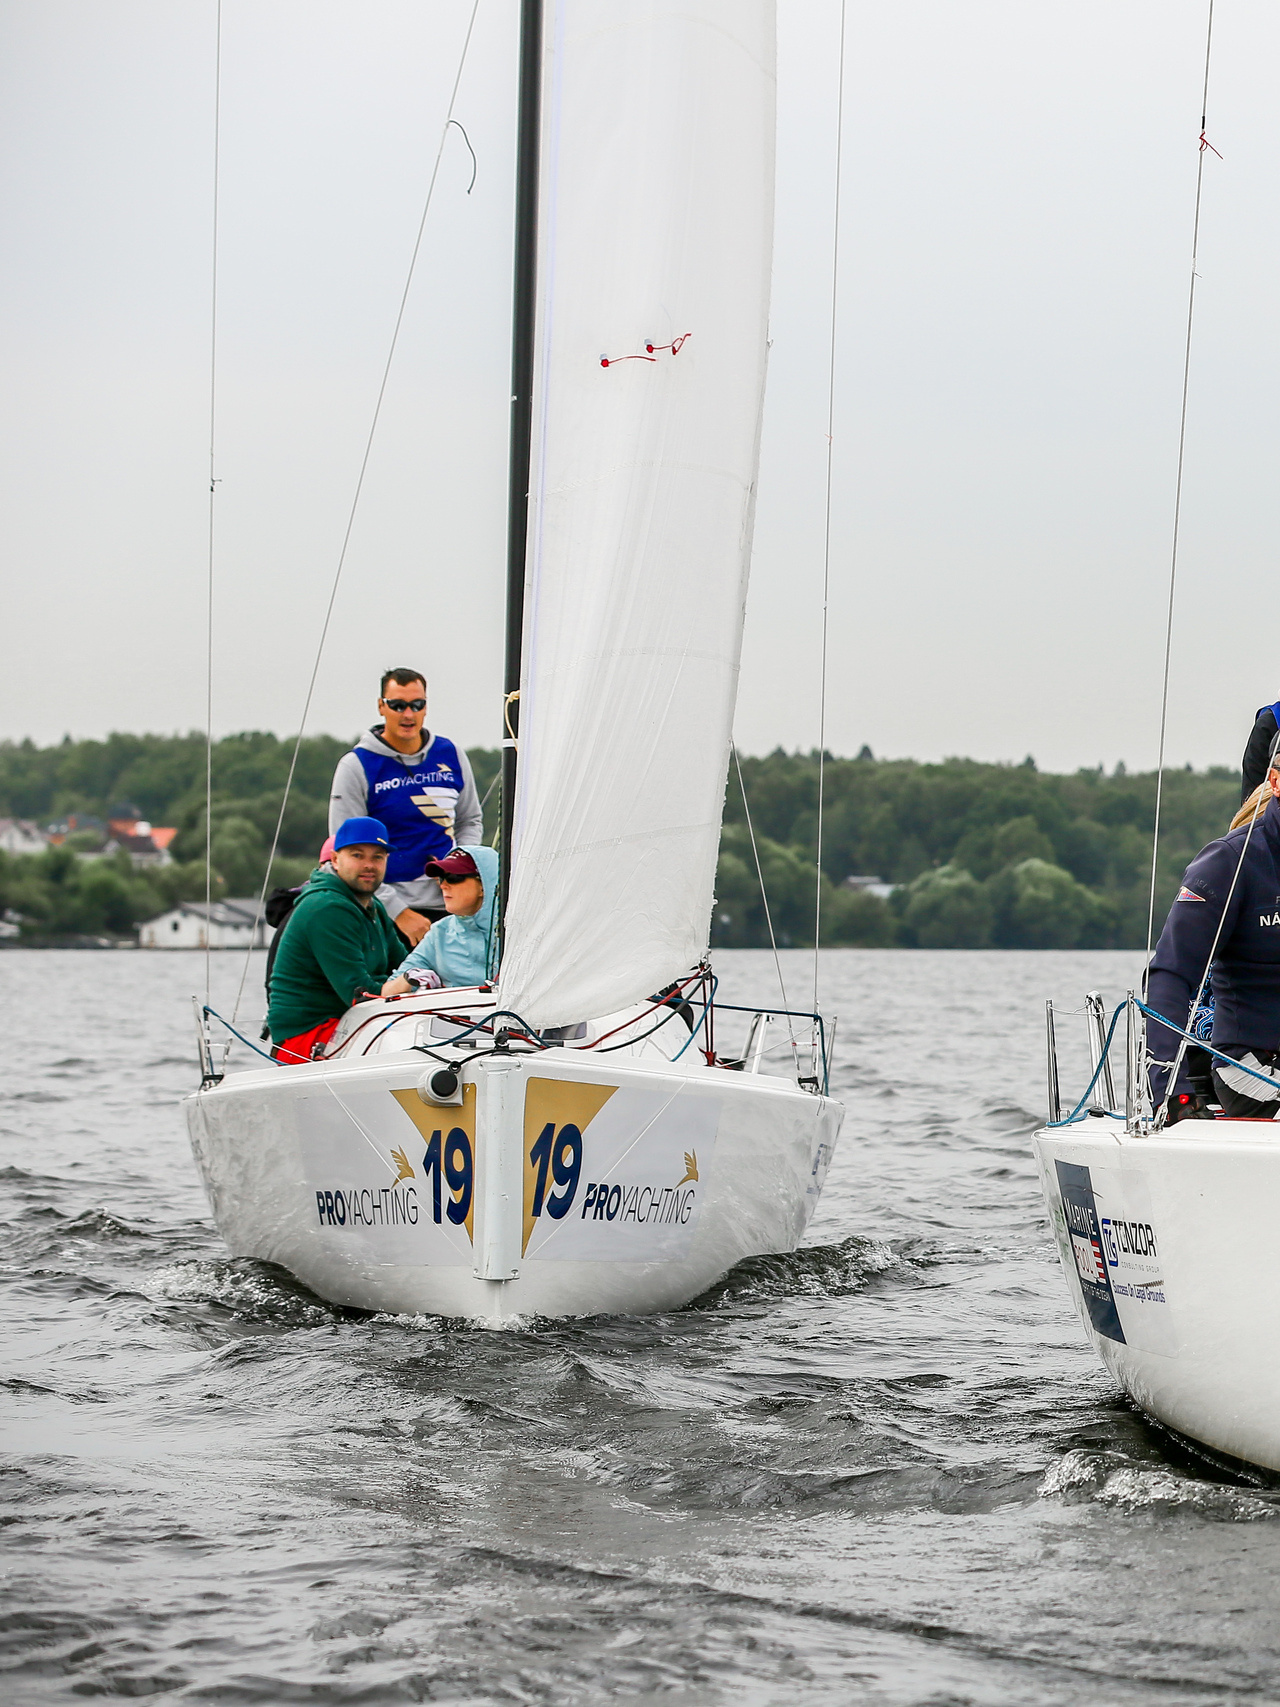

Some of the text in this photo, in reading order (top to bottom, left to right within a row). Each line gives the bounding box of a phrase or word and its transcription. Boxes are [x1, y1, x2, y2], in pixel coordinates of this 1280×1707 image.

[375, 771, 455, 794] PROYACHTING
[422, 1127, 473, 1225] 19
[530, 1122, 582, 1219] 19
[316, 1187, 418, 1226] PROYACHTING
[581, 1183, 695, 1224] PROYACHTING
